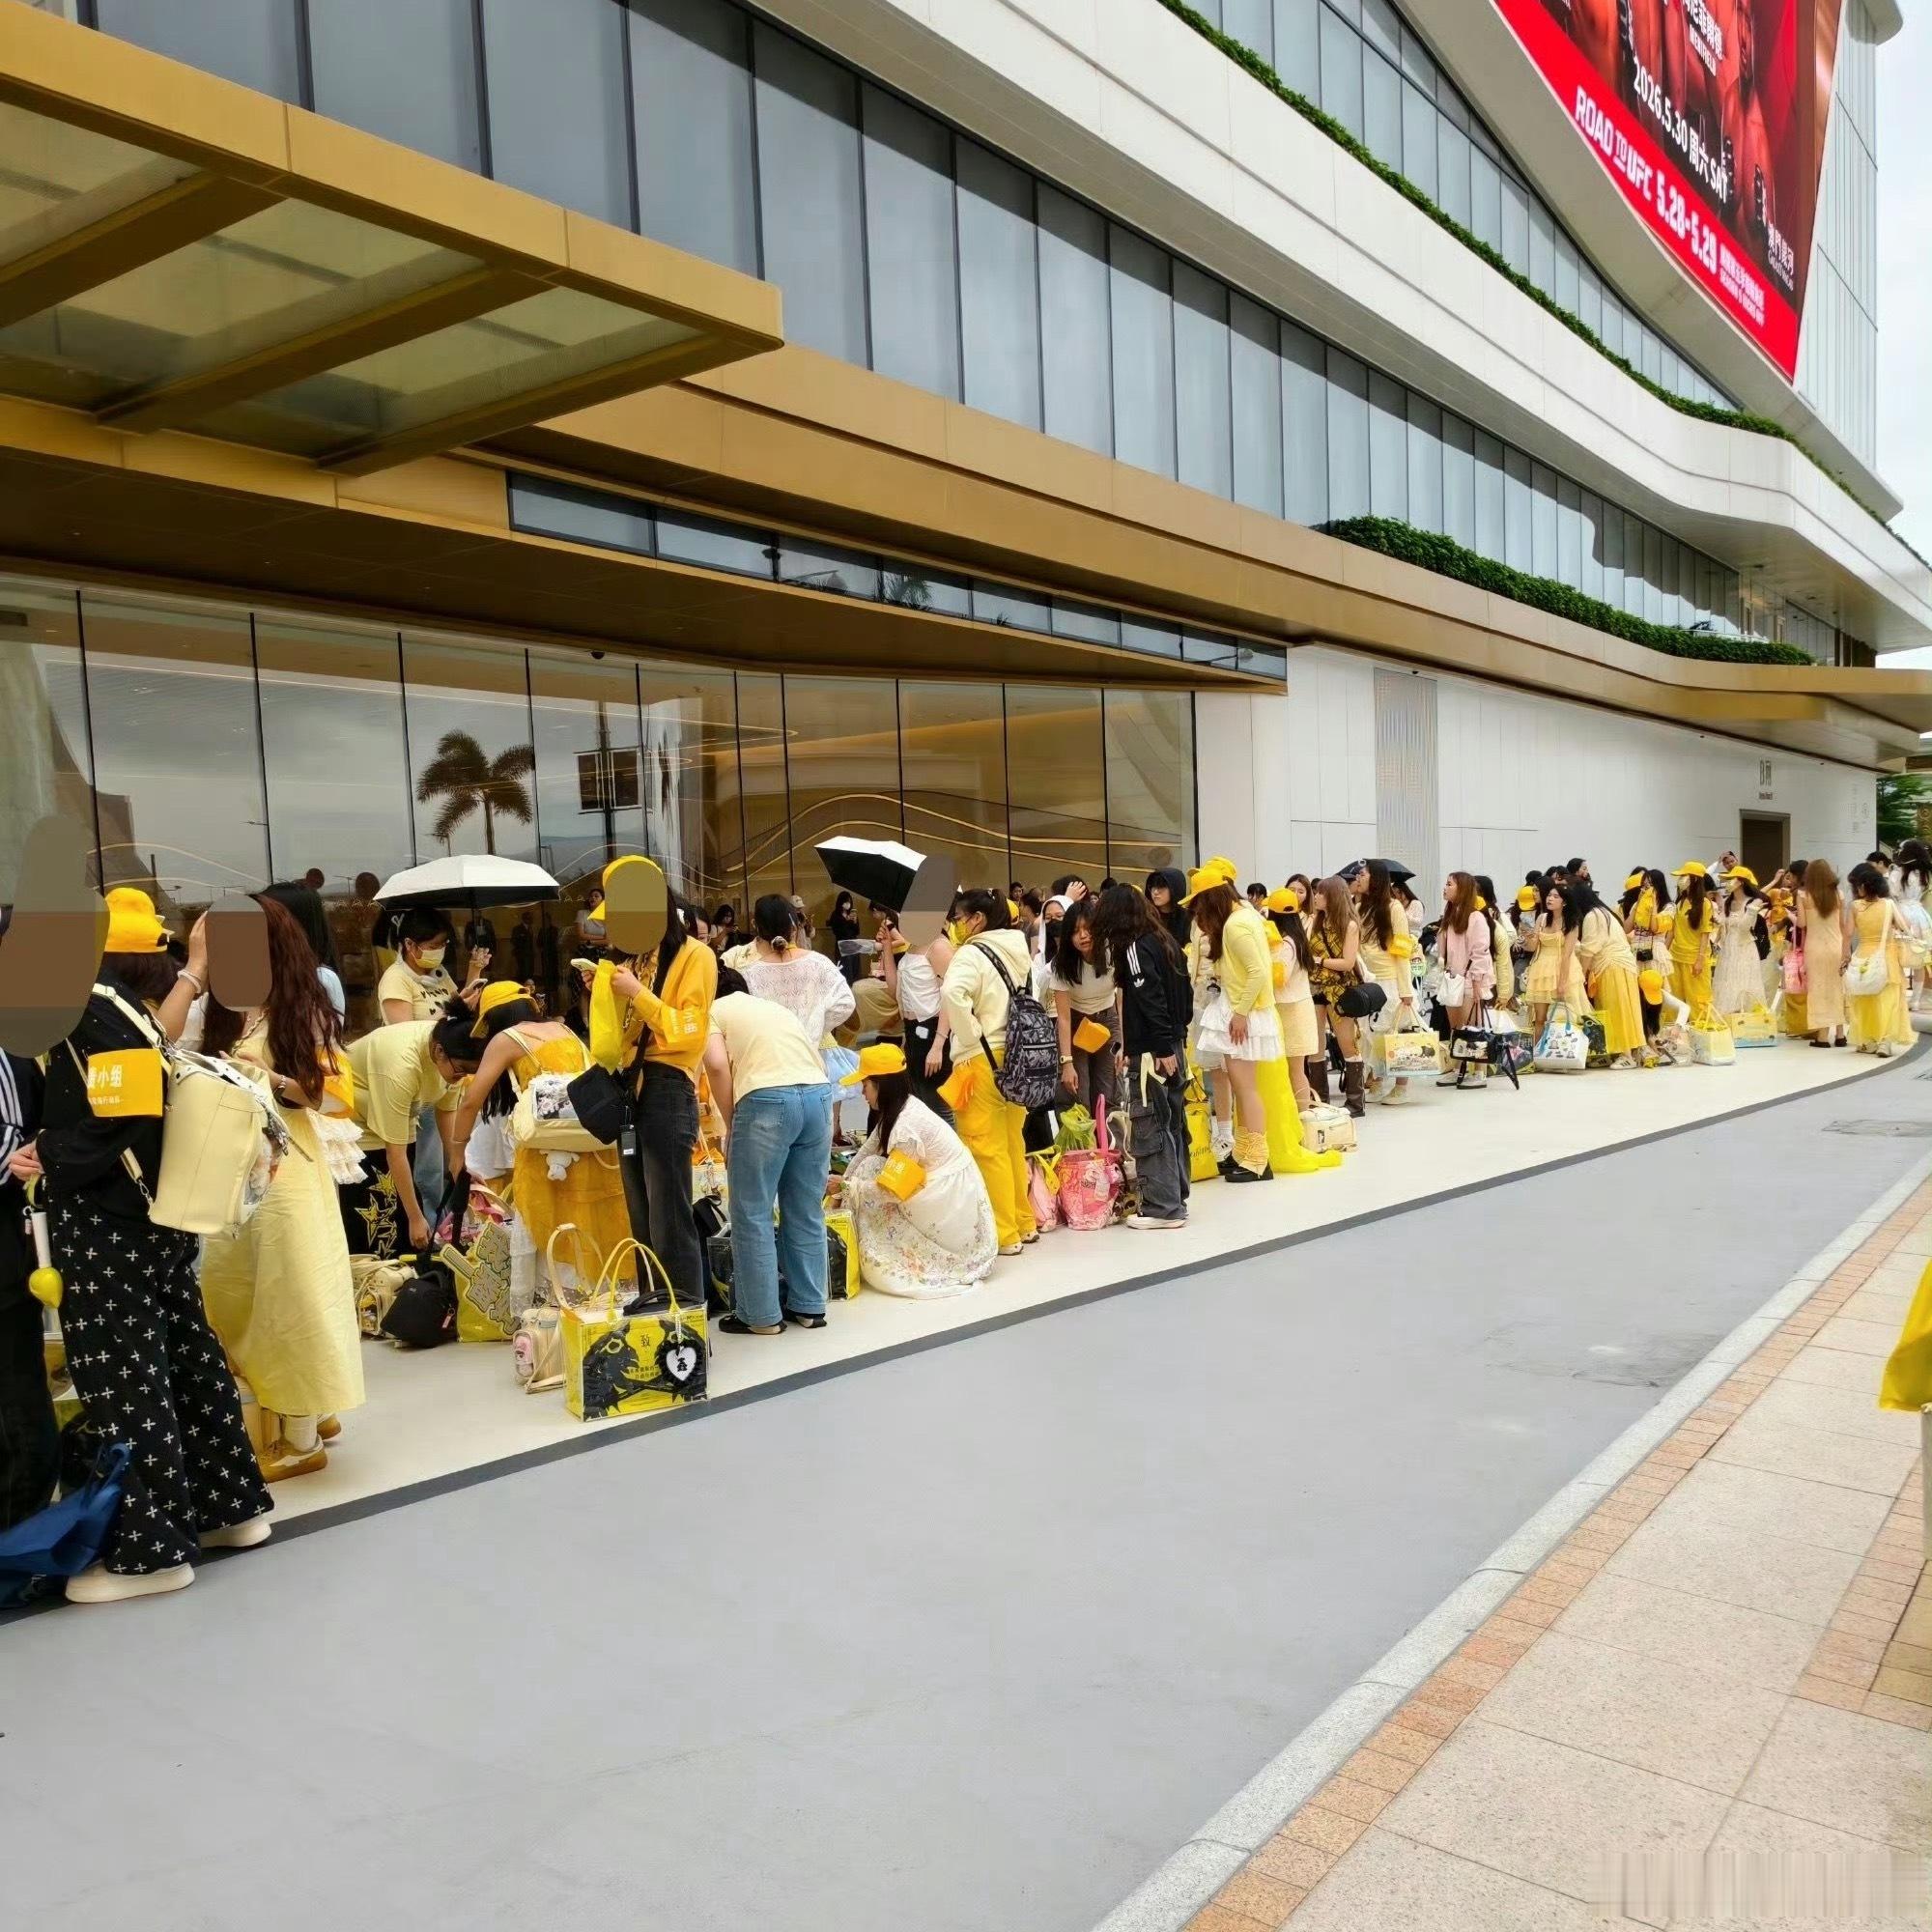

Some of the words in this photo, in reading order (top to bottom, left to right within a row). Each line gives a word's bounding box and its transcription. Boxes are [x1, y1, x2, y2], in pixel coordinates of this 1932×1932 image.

[1575, 85, 1613, 156] ROAD
[1615, 129, 1628, 164] TO
[1626, 145, 1653, 201] UFC
[1657, 169, 1718, 275] 5.28-5.29
[1633, 56, 1688, 153] 2026.5.30
[1690, 127, 1709, 184] 周六
[1710, 157, 1727, 204] SAT
